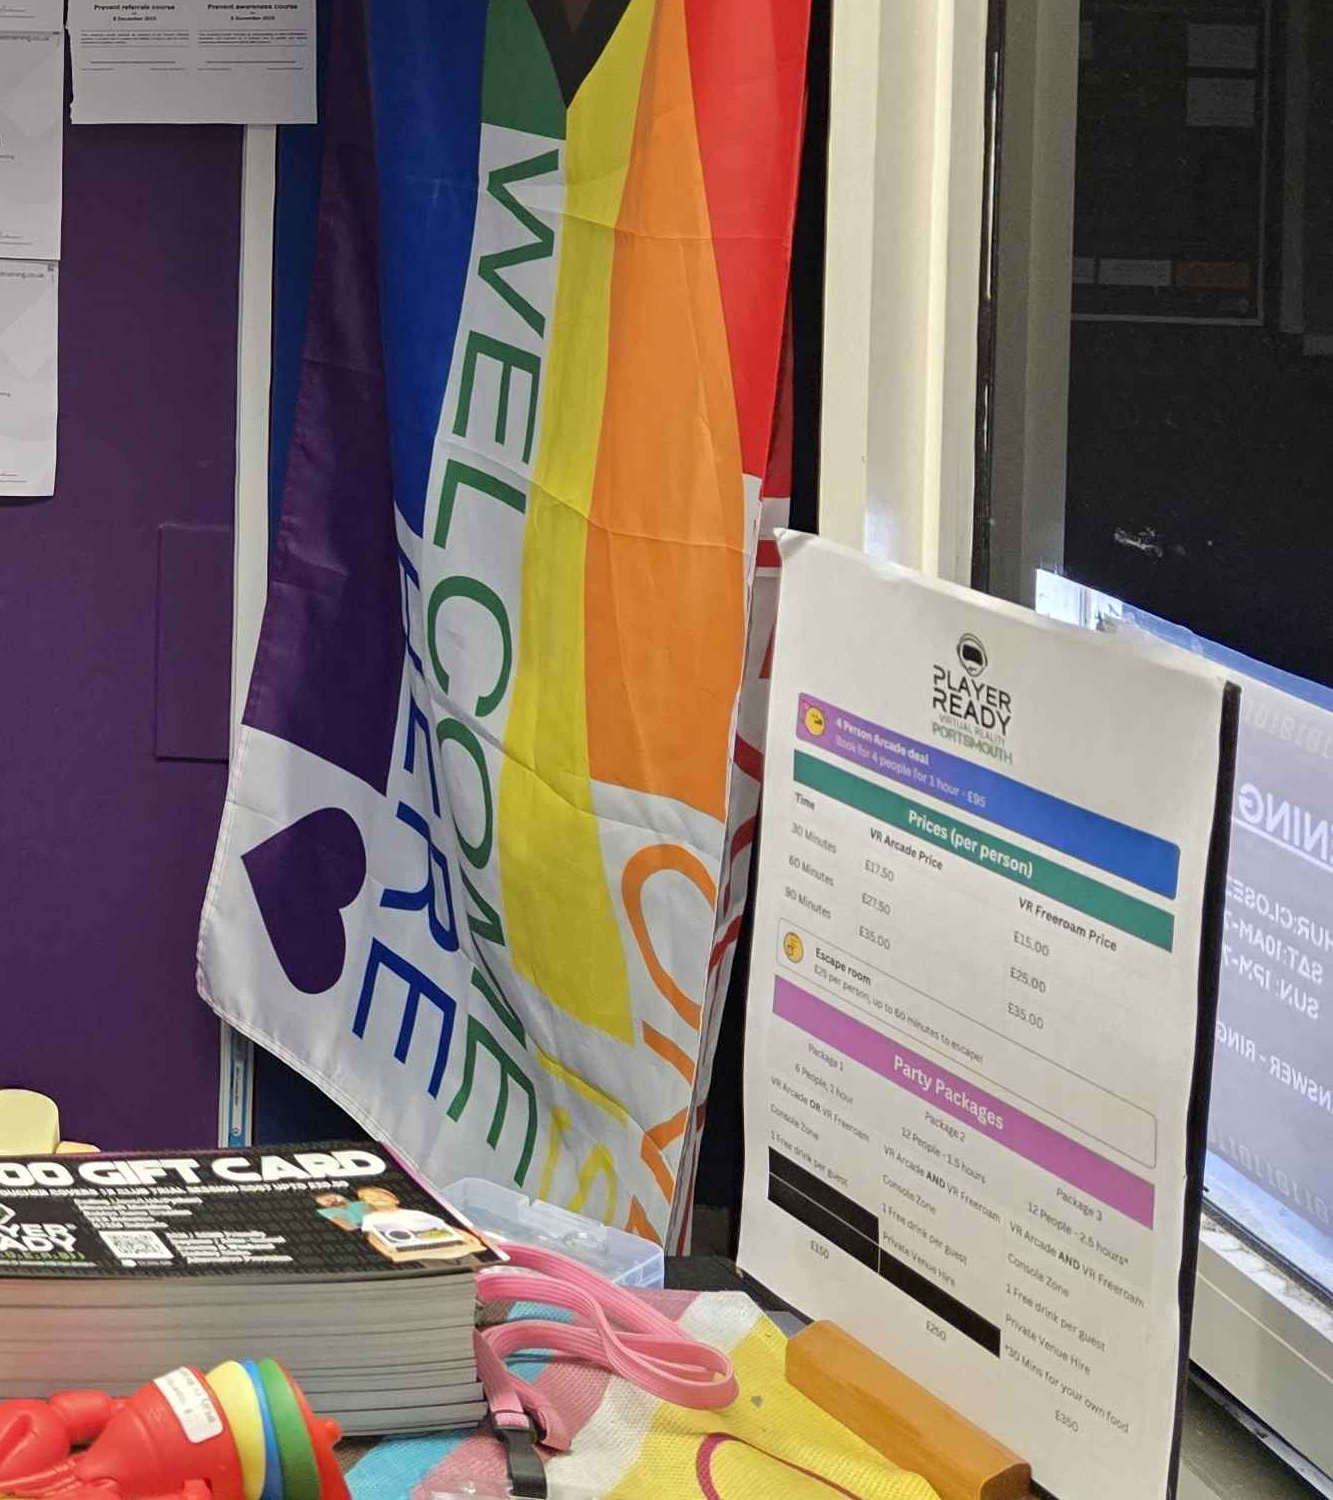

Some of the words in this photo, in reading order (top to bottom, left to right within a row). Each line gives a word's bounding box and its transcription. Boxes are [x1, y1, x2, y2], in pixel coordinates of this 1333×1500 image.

[427, 148, 561, 1188] WELCOME
[932, 664, 1013, 714] PLAYER
[932, 686, 1012, 737] READY
[843, 719, 872, 743] Person
[873, 733, 906, 758] Arcade
[908, 747, 929, 767] deal
[932, 723, 1014, 766] PORTSMOUTH
[795, 792, 816, 811] Time
[791, 823, 804, 837] 30
[804, 828, 837, 856] Minutes
[870, 828, 883, 844] VR
[883, 833, 917, 861] Arcade
[918, 846, 943, 871] Price
[908, 810, 949, 844] Prices
[950, 827, 978, 858] (per
[980, 841, 1034, 879] person)
[789, 855, 801, 870] 60
[801, 860, 834, 887] Minutes
[865, 859, 895, 883] £17.50
[785, 886, 797, 901] 90
[798, 892, 832, 920] Minutes
[861, 892, 892, 916] £27.50
[858, 925, 891, 950] £35.00
[1019, 897, 1035, 913] VR
[1035, 903, 1087, 940] Freeroam
[1088, 926, 1118, 952] Price
[1013, 931, 1050, 958] £15.00
[815, 947, 847, 975] Escape
[848, 964, 873, 987] room
[1009, 966, 1047, 994] £25.00
[1007, 1002, 1045, 1030] £35.00
[893, 1053, 934, 1095] Party
[934, 1076, 1006, 1132] Packages
[78, 1157, 204, 1187] GIFT
[210, 1150, 387, 1183] CARD
[925, 1320, 948, 1342] £250
[1053, 1409, 1080, 1433] £350
